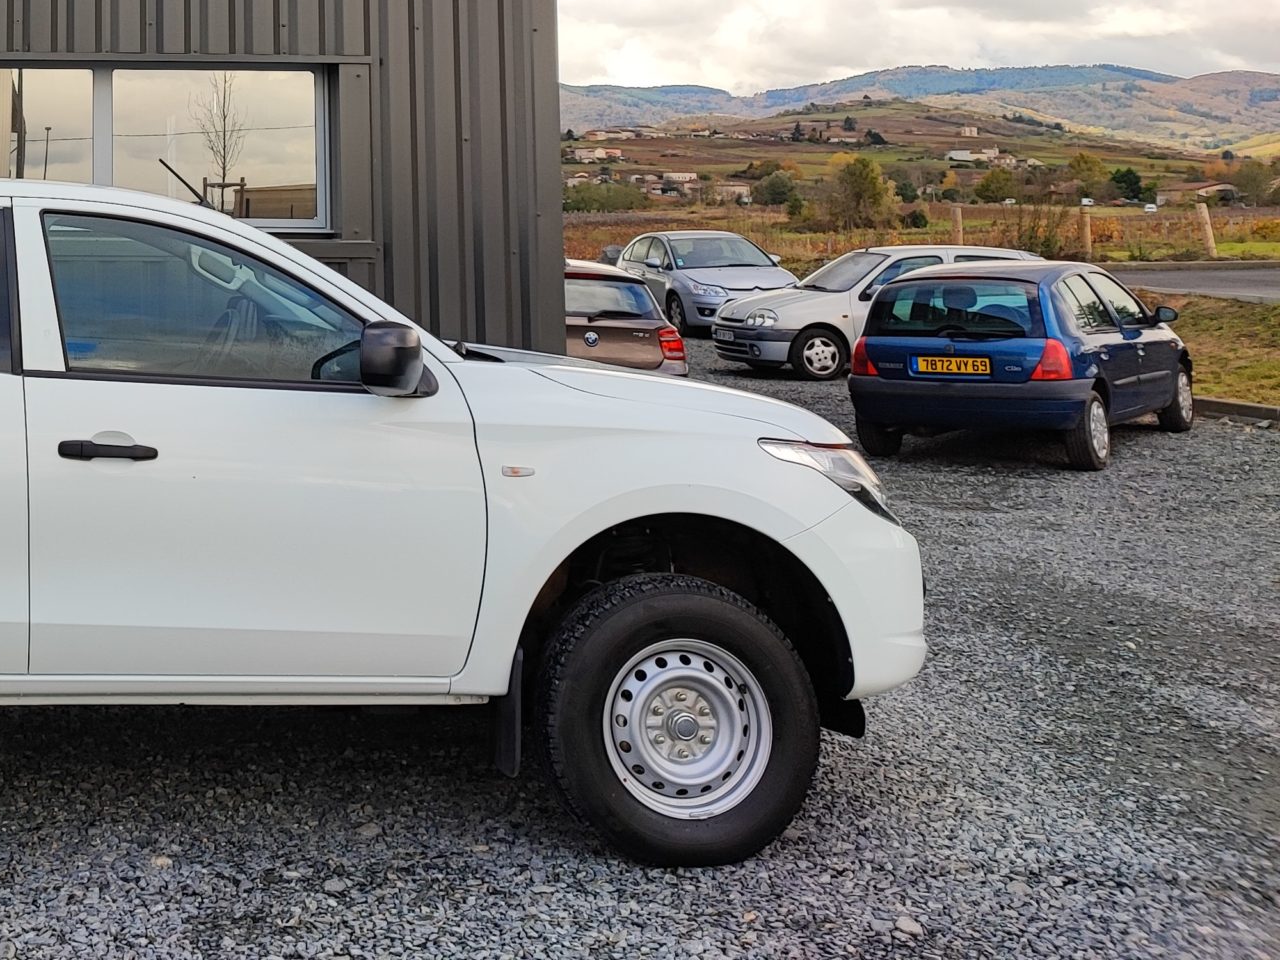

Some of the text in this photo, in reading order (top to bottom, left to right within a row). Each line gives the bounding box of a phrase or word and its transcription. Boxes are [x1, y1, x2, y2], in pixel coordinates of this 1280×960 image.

[922, 359, 988, 372] 7872 VY 69
